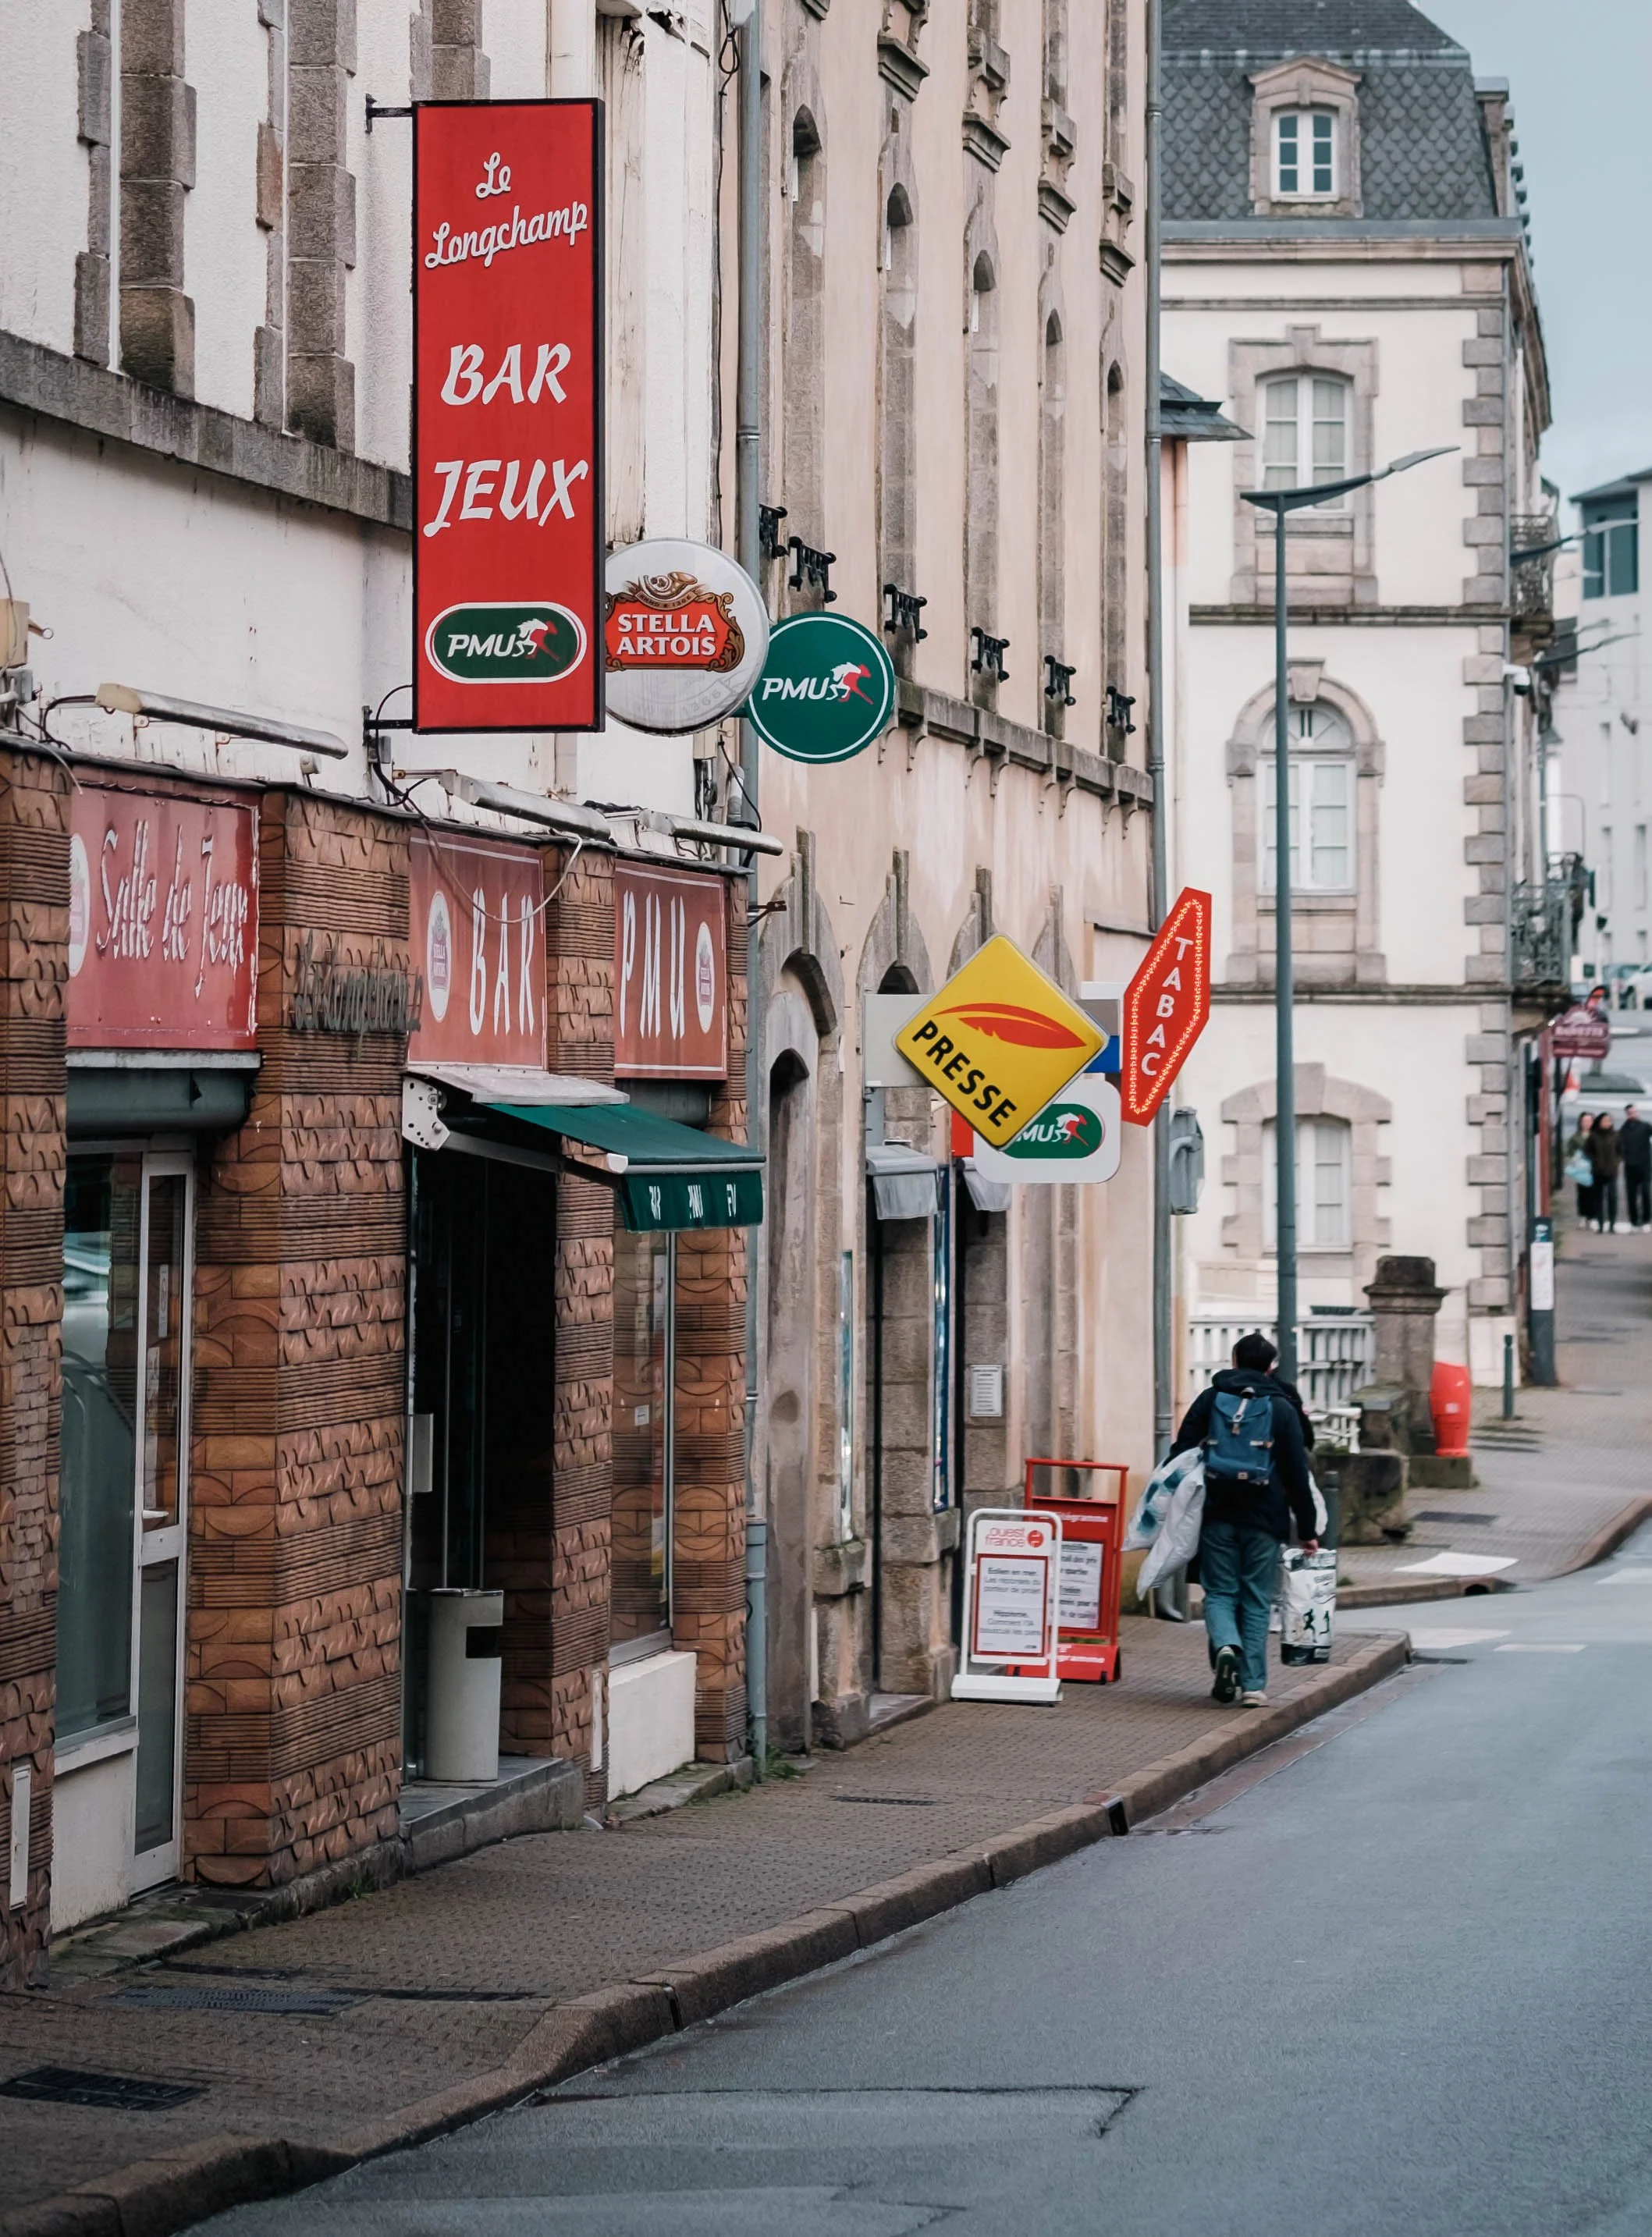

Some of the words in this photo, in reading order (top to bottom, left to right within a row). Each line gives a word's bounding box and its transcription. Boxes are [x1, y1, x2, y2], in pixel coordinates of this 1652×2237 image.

[475, 152, 511, 198] Le
[425, 201, 588, 268] Longchamp
[440, 343, 571, 406] BAR
[423, 459, 589, 538] JEUX
[447, 634, 513, 658] PMU
[616, 636, 716, 656] ARTOIS
[617, 614, 715, 633] STELLA
[762, 676, 833, 702] PMU
[469, 888, 535, 1036] BAR
[620, 889, 686, 1041] PMU
[1141, 936, 1194, 1077] TABAC
[911, 1021, 1018, 1127] PRESSE
[1016, 1124, 1055, 1142] MU
[985, 1535, 1025, 1548] france
[990, 1527, 1025, 1537] ouest
